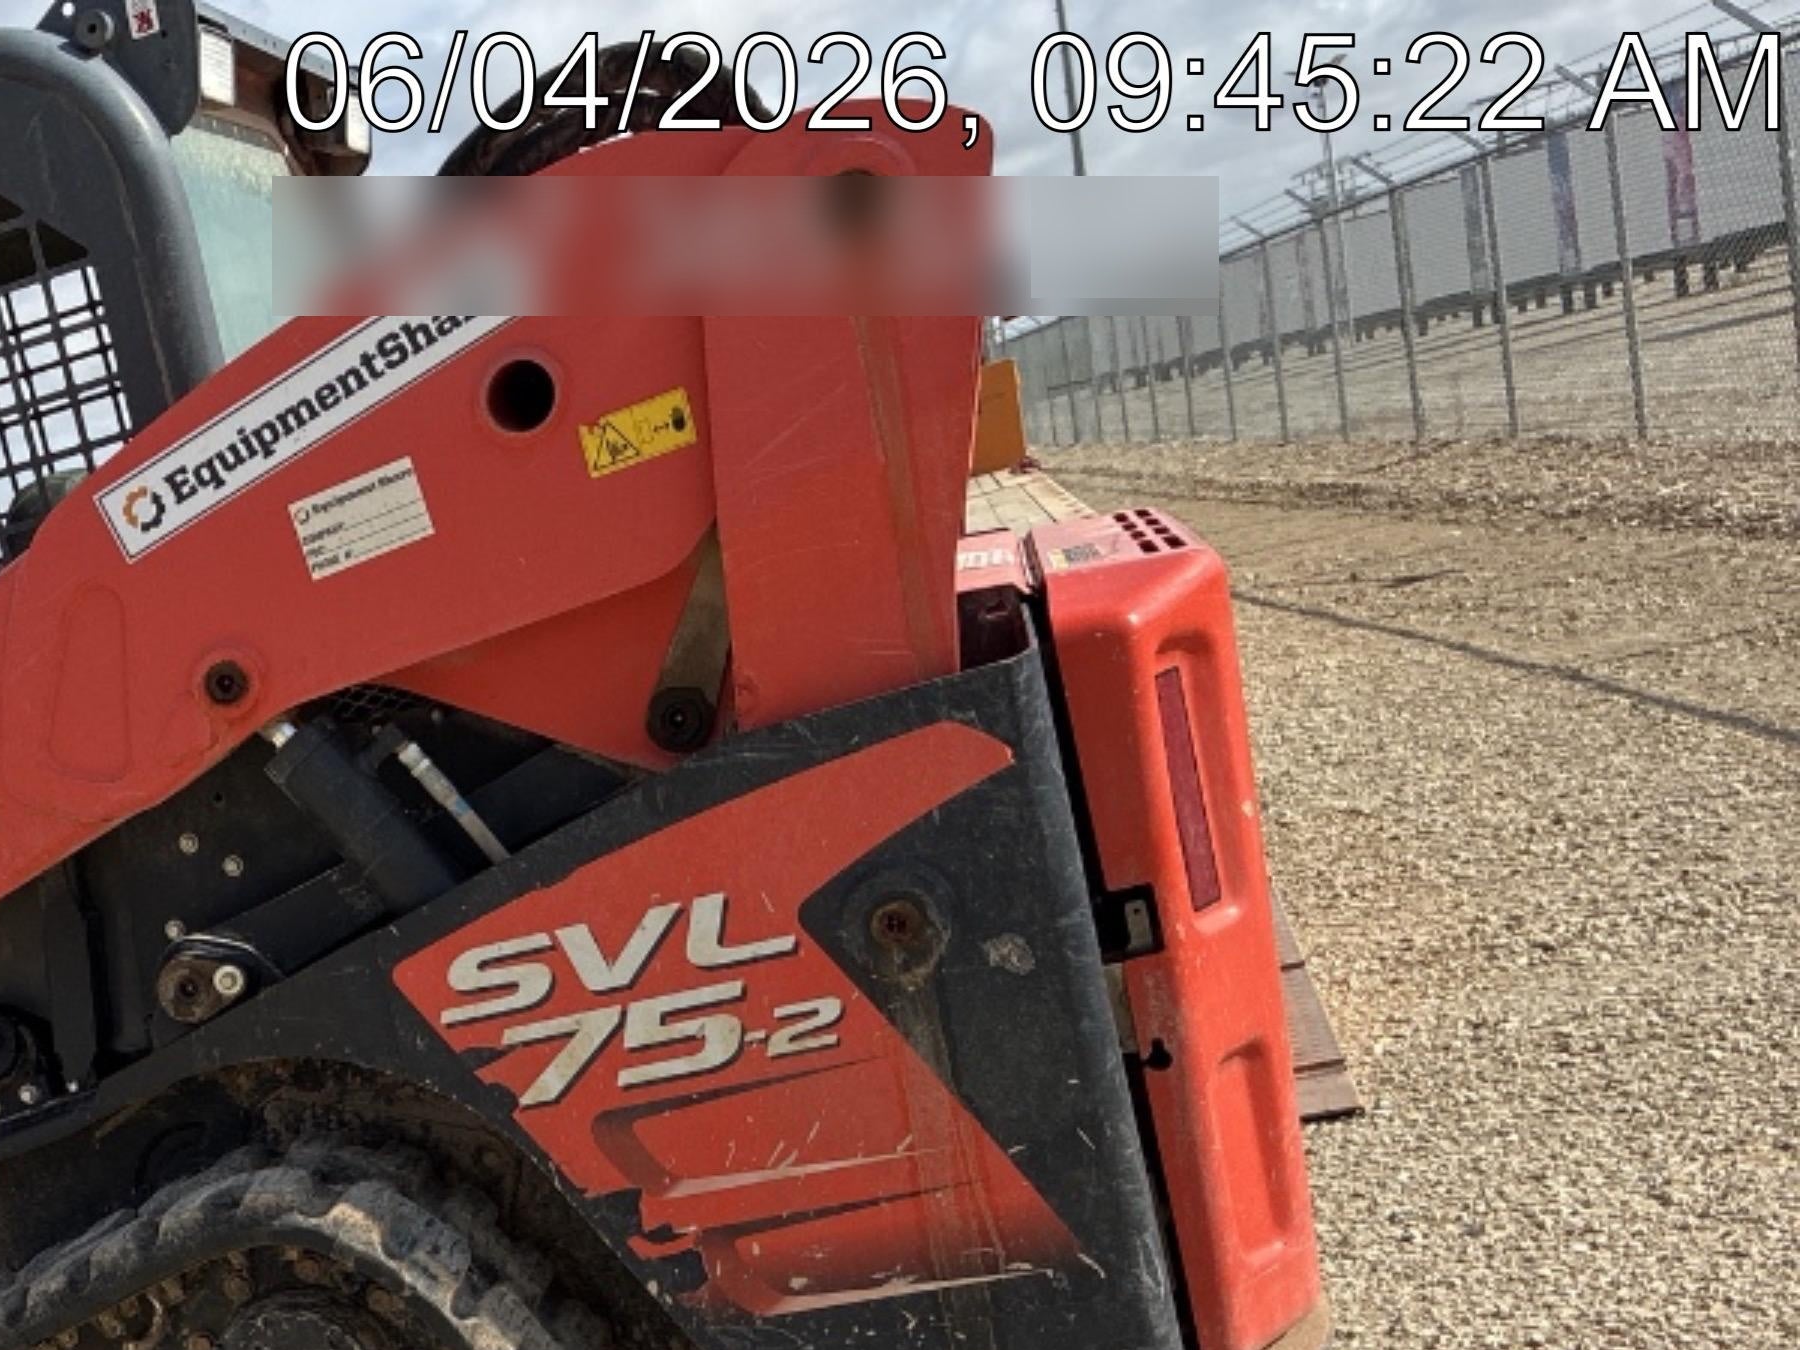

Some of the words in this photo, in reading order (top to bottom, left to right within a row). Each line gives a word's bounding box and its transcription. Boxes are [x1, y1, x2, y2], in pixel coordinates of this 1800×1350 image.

[163, 316, 478, 504] EquipmentSha
[440, 893, 798, 1025] SVL
[501, 980, 843, 1107] 75-2
